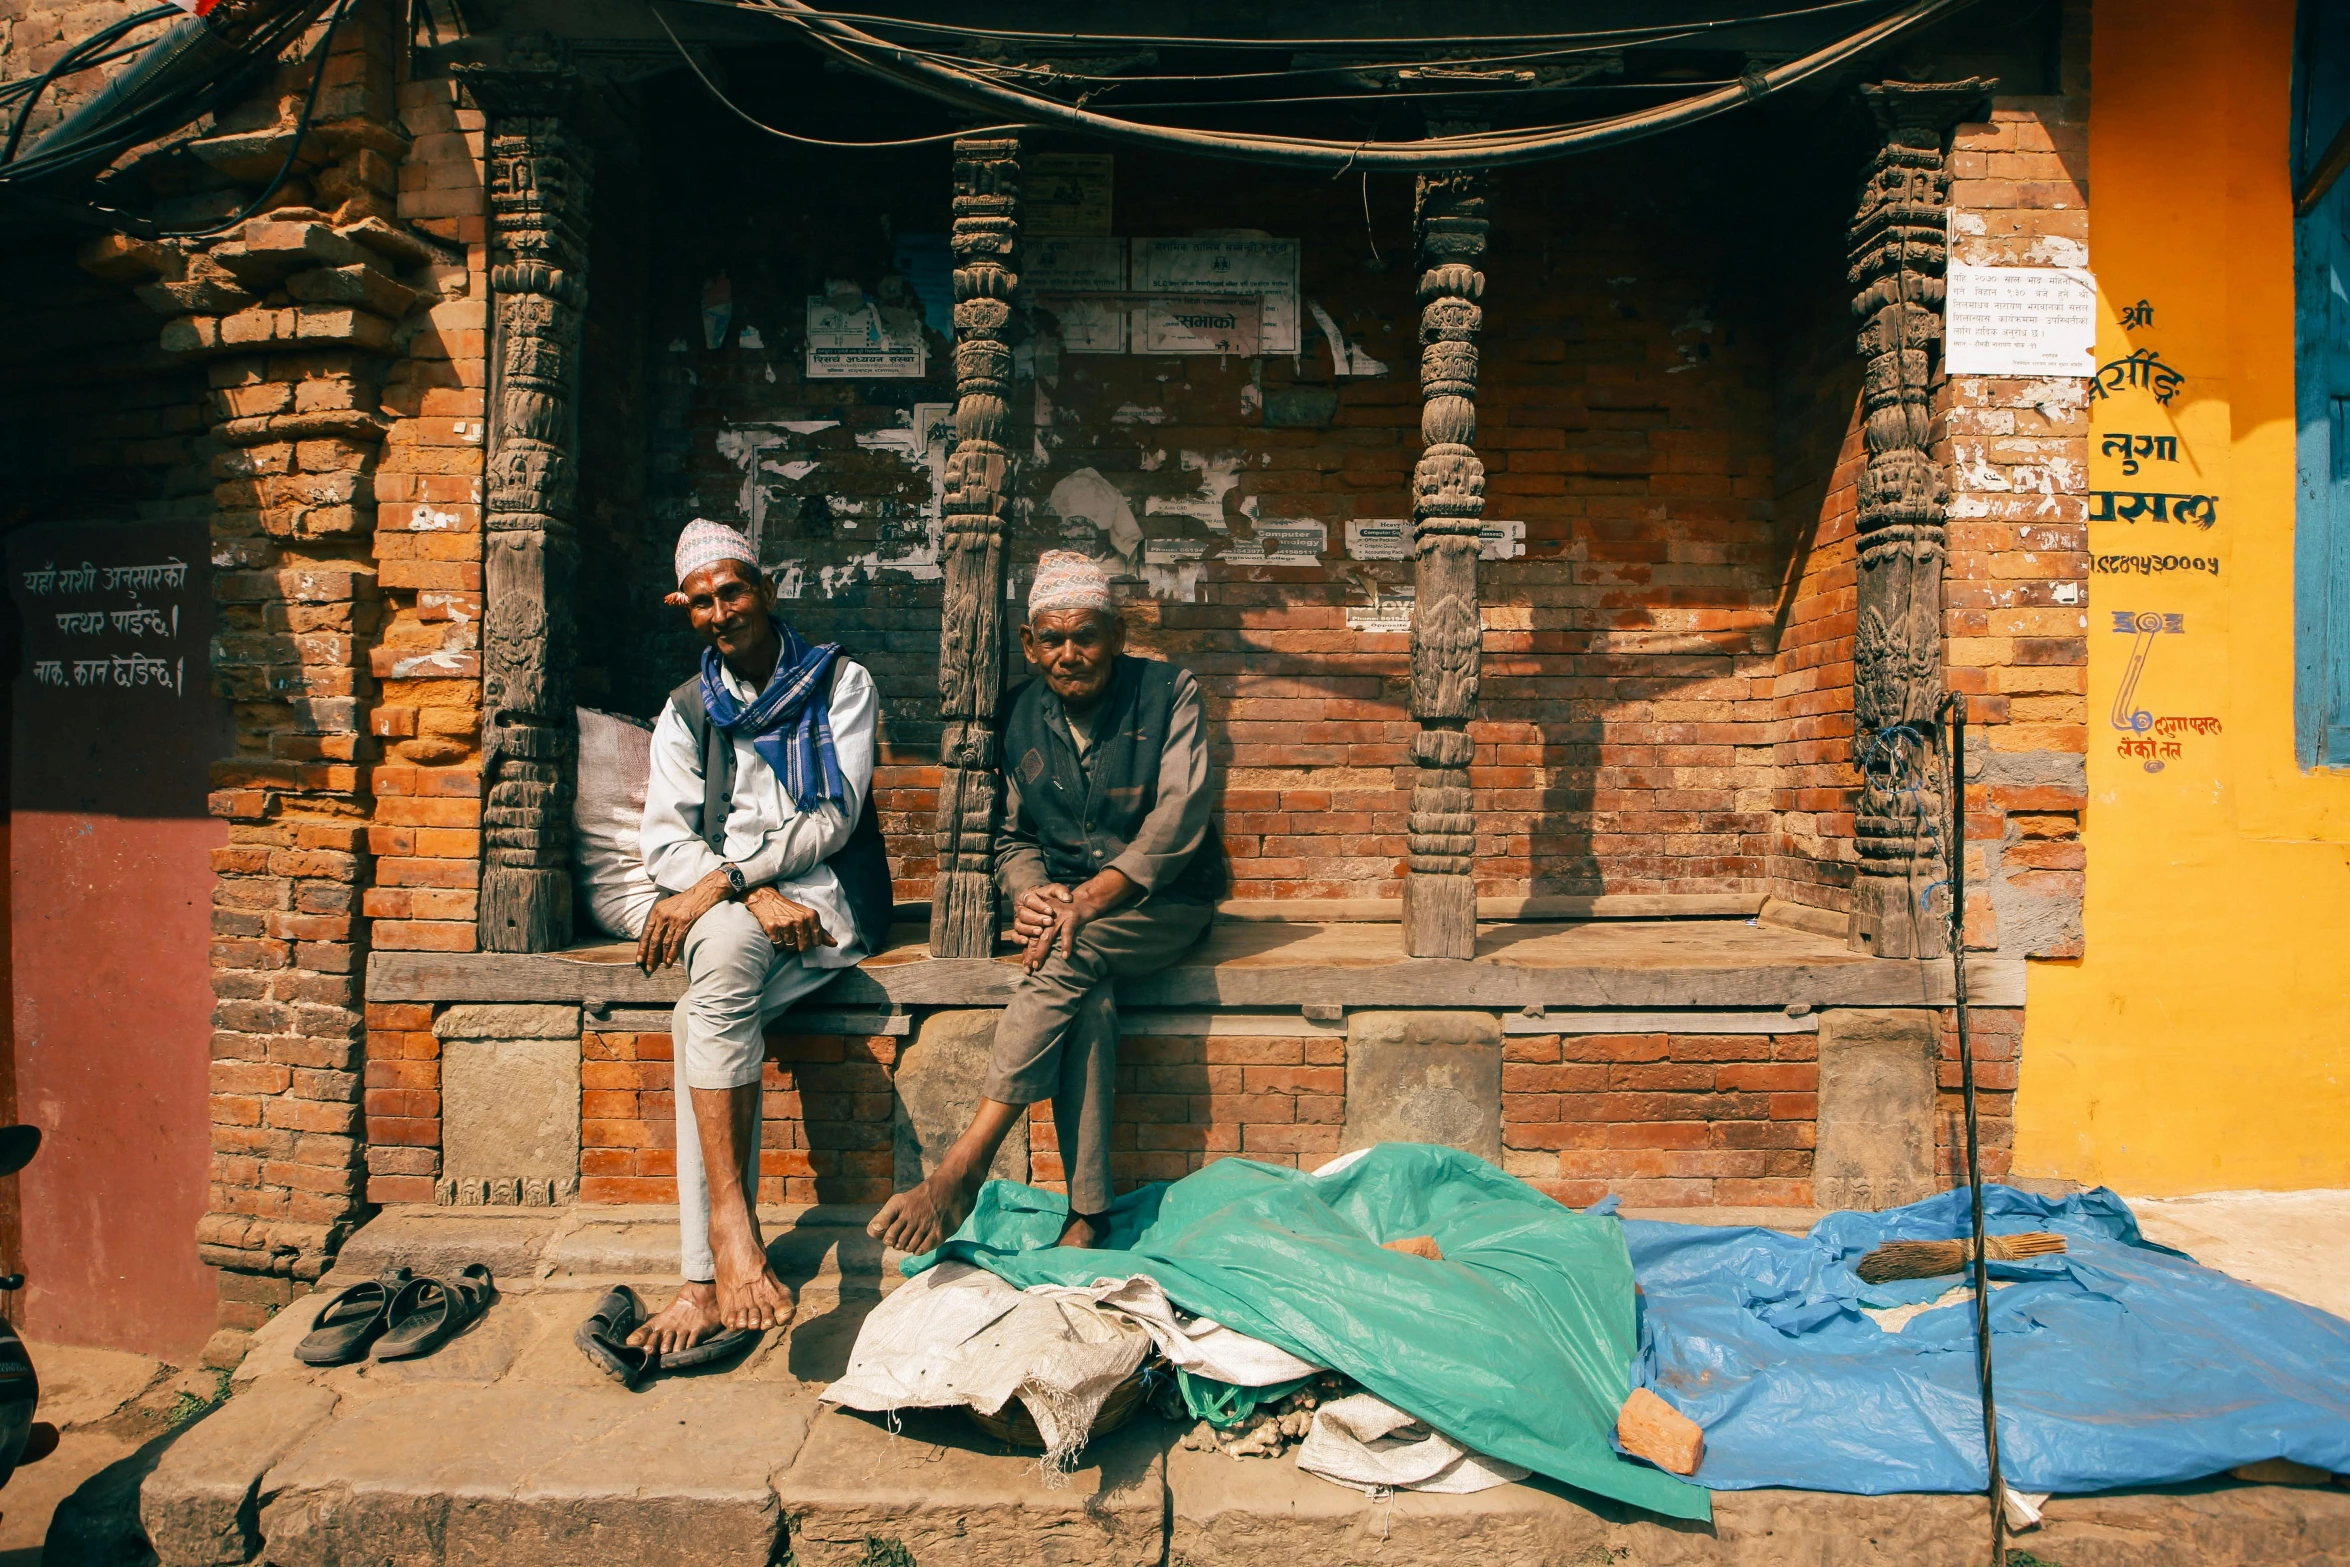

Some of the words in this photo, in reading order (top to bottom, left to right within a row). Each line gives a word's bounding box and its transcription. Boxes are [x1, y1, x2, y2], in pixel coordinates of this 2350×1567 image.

[1974, 275, 1997, 283] २०७०
[2004, 276, 2020, 284] साल
[1953, 286, 1965, 297] गते
[1975, 286, 1997, 297] विहान
[2035, 289, 2048, 299] बजे
[2057, 288, 2069, 301] हुने
[2078, 288, 2089, 299] श्री
[1994, 301, 2022, 311] नारायण
[1174, 312, 1237, 329] सभाको
[1953, 312, 1991, 324] शिलान्यास
[2116, 299, 2155, 331] श्री
[2002, 327, 2027, 339] अनुरोध
[889, 355, 915, 363] संस्था
[2101, 433, 2180, 476] लुगा
[23, 561, 57, 595] यहाँ
[59, 561, 97, 594] राशी
[101, 556, 188, 600] अनुसारको
[56, 612, 105, 636] पत्थर
[73, 660, 110, 687] कान
